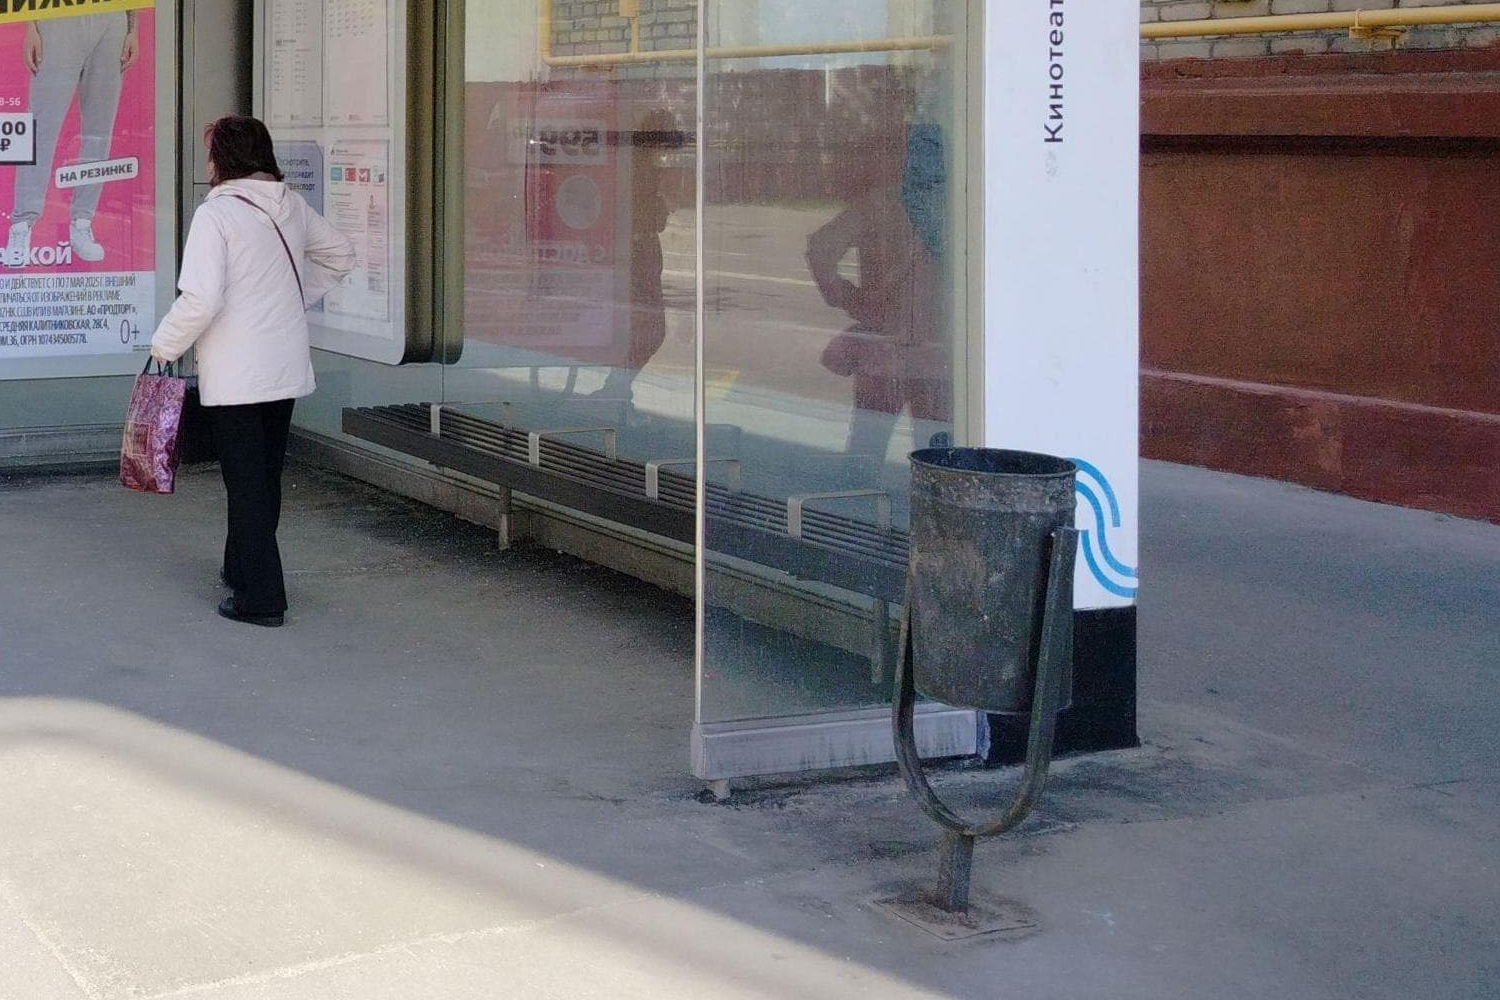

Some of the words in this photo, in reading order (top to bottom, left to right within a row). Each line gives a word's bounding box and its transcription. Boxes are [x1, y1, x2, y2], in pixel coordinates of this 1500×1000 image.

[1, 121, 26, 135] 00
[59, 171, 77, 183] НА
[80, 163, 133, 181] РЕЗИНКЕ
[87, 305, 96, 315] АО
[120, 320, 140, 344] 0+
